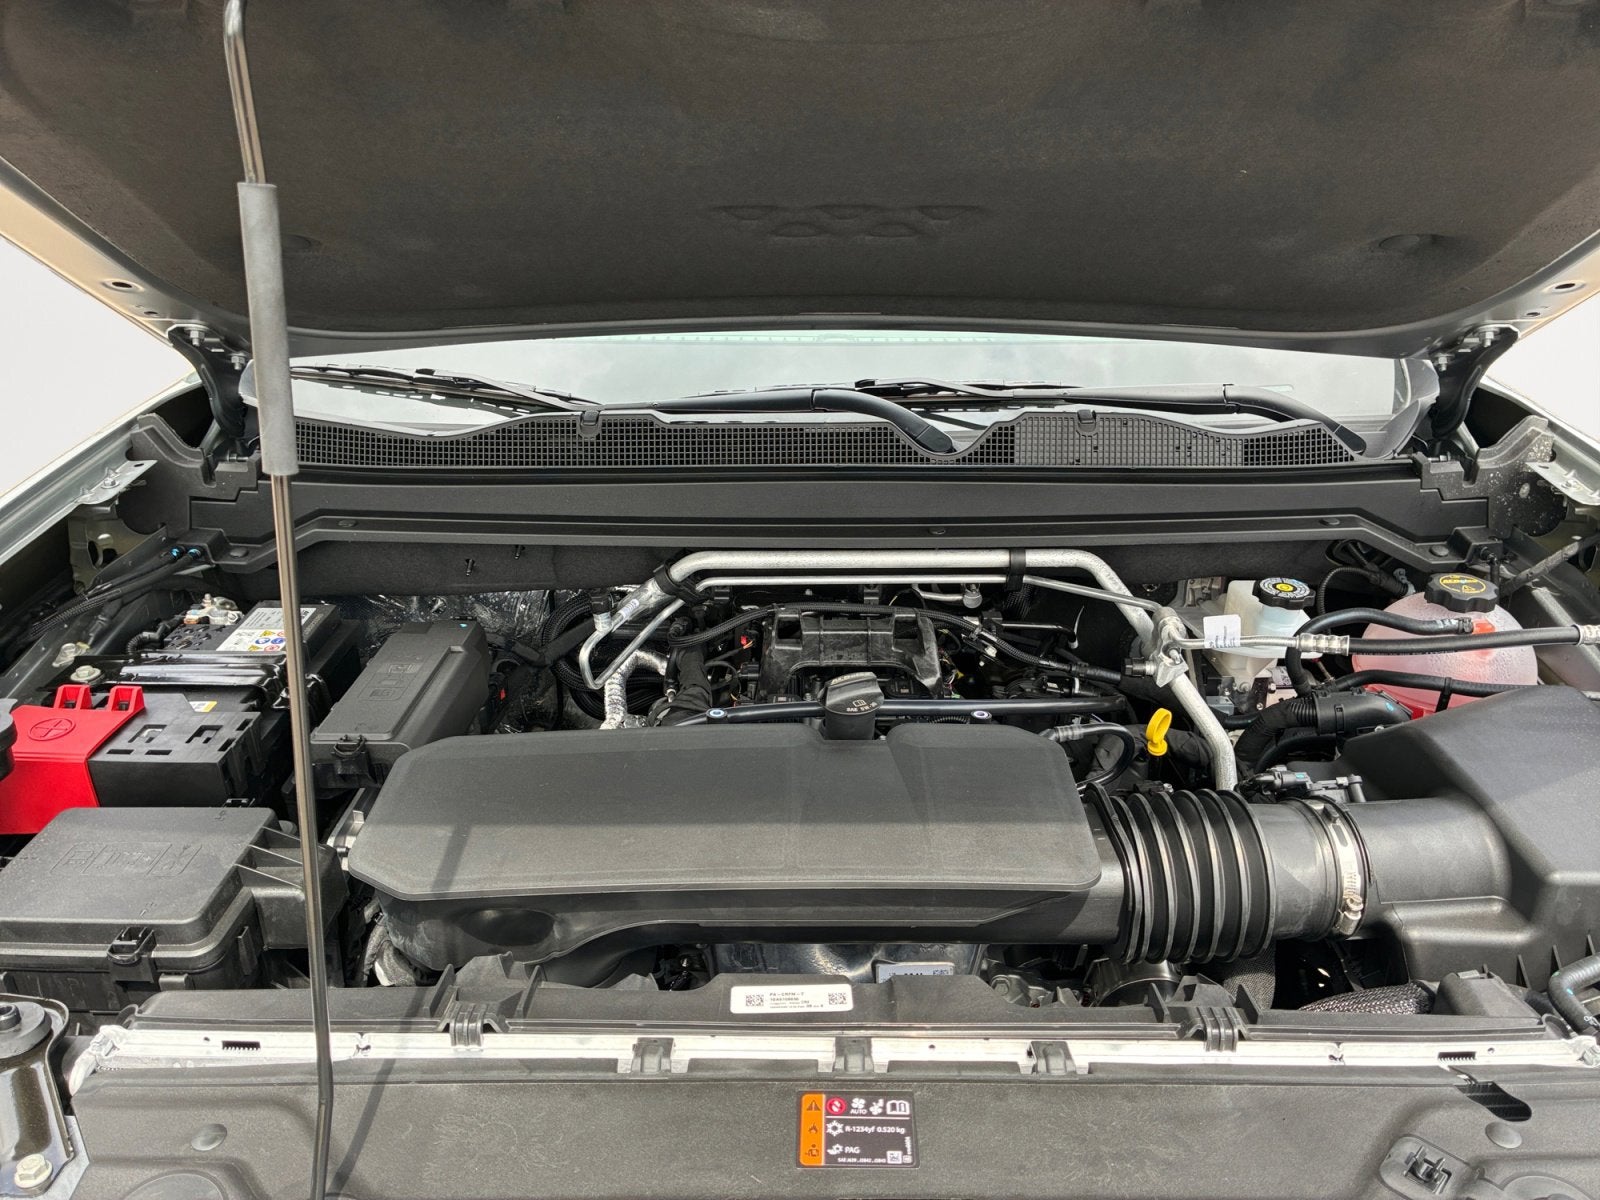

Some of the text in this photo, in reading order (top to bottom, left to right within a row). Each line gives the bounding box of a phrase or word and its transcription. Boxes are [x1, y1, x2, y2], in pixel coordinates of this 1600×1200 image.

[845, 1126, 876, 1134] R-1234yf
[895, 1127, 906, 1135] kg
[844, 1146, 861, 1154] PAG
